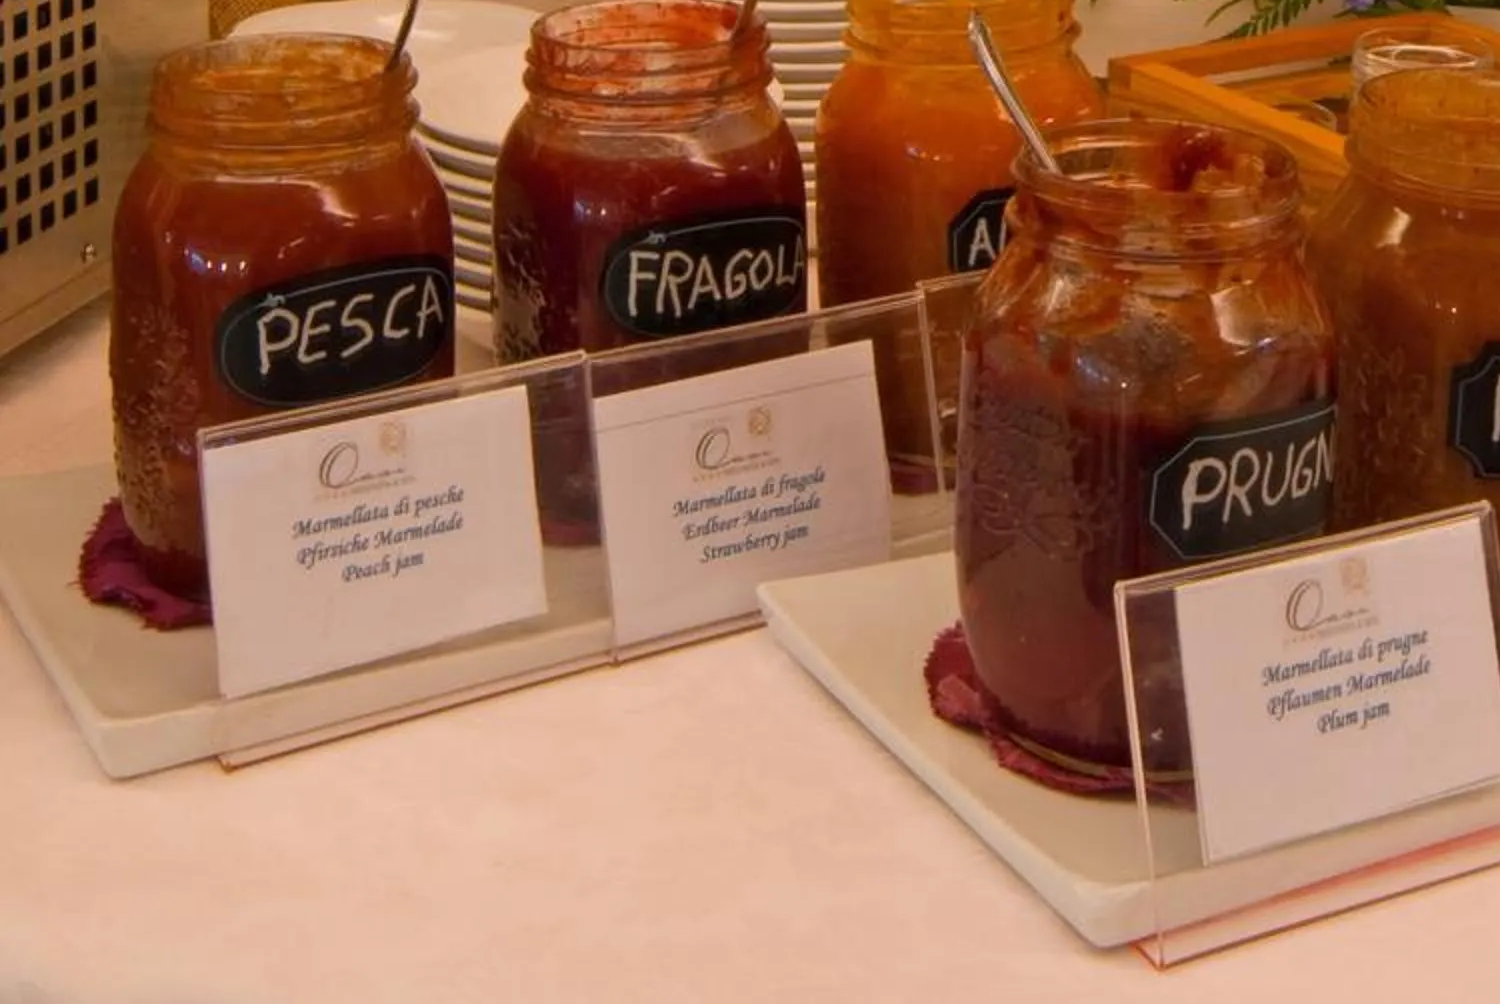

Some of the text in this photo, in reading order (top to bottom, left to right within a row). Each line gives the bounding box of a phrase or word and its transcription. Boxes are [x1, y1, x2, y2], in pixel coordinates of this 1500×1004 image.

[256, 275, 444, 375] PESCA
[291, 485, 465, 539] Marmellata di pesche
[672, 486, 757, 517] Marmellata
[761, 476, 774, 497] di
[296, 511, 464, 569] Pfirsiche Marmelade
[341, 552, 424, 582] Peach jam
[699, 524, 809, 563] Strawberry jam
[1261, 629, 1428, 686] Marmellata di prugne
[1266, 654, 1432, 722] Pflaumen Marmelade
[1316, 701, 1390, 734] Plum jam
